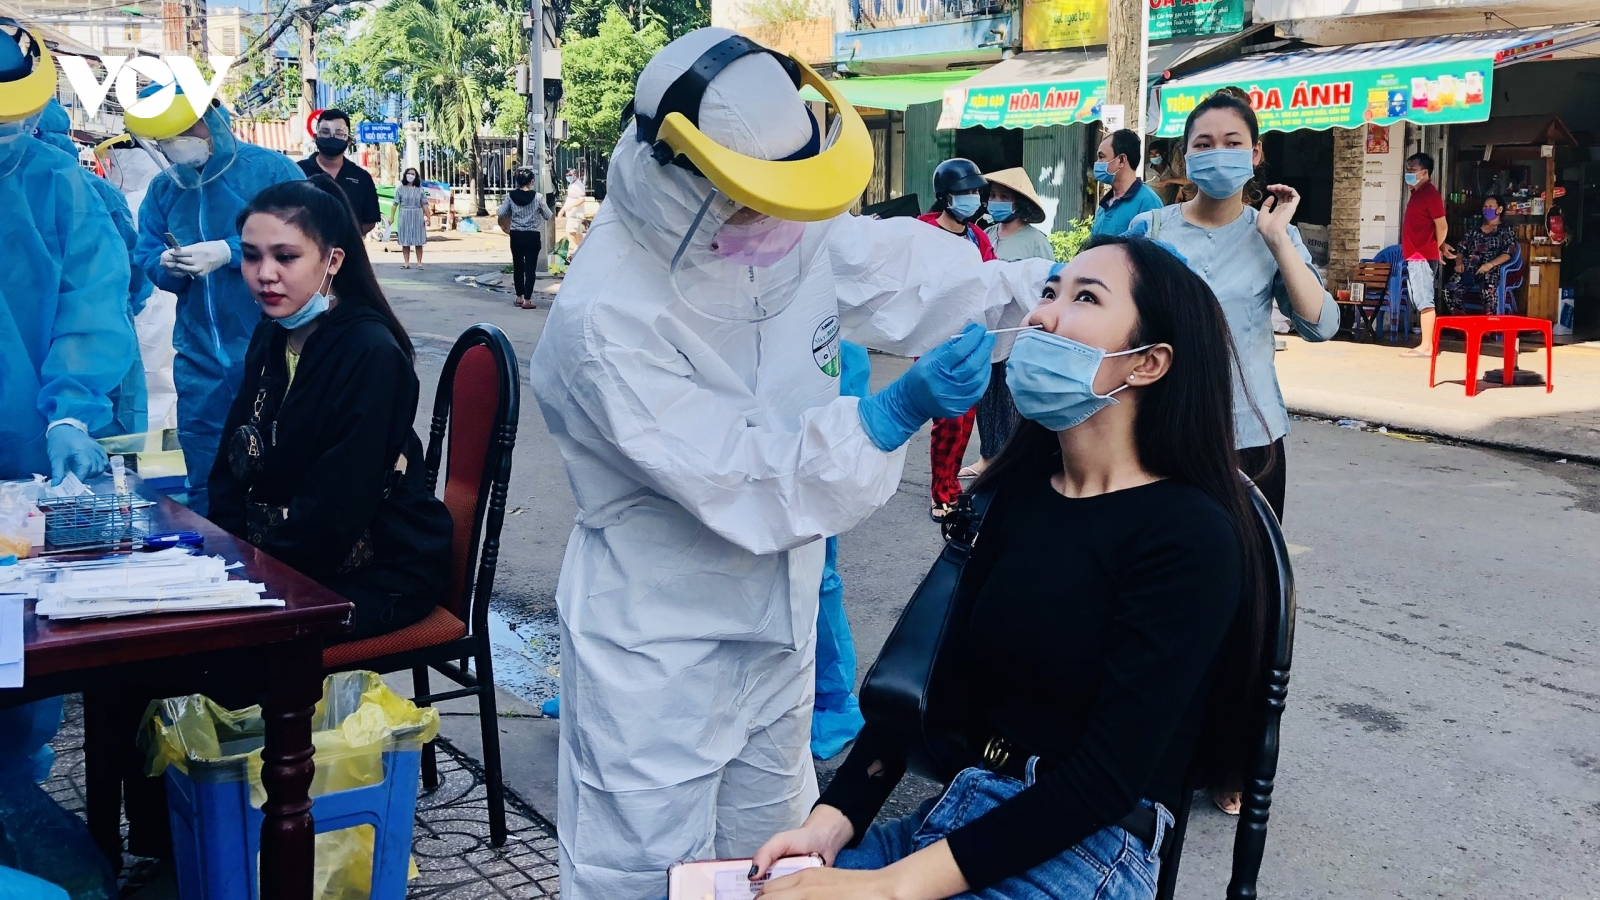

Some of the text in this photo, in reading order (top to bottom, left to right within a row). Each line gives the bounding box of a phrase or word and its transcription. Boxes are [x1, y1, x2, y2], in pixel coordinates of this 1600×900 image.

[989, 93, 1005, 109] GẠO
[1009, 89, 1040, 111] HÒA
[1044, 87, 1080, 109] ÁNH
[1167, 93, 1196, 114] TIỆM
[1248, 81, 1353, 111] ÒA ÁNH
[365, 131, 375, 140] NGÔ
